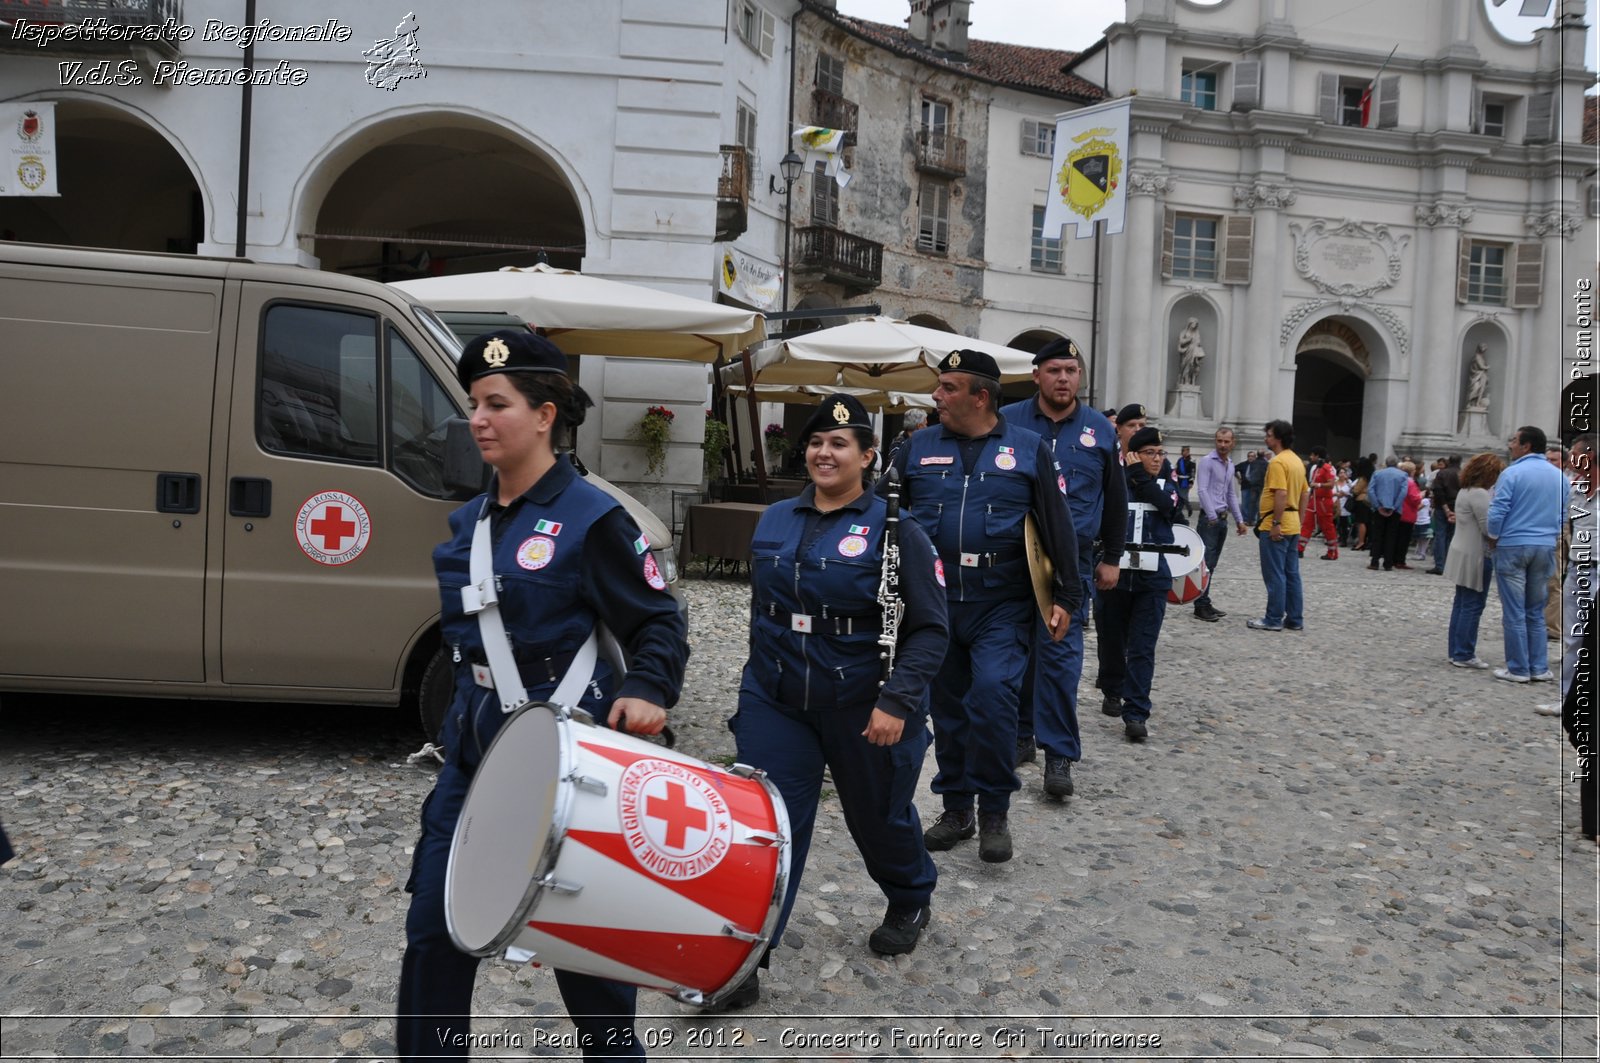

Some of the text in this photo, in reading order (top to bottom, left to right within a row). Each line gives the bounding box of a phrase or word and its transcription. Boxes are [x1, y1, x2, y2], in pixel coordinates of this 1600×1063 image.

[297, 492, 369, 535] CROCE ROSSA ITALIANA
[302, 543, 363, 564] CORPO MILITARE
[622, 771, 641, 831] GINEVRA
[703, 788, 726, 815] 1864
[630, 831, 646, 849] DI
[639, 837, 726, 878] CONVENZIONE
